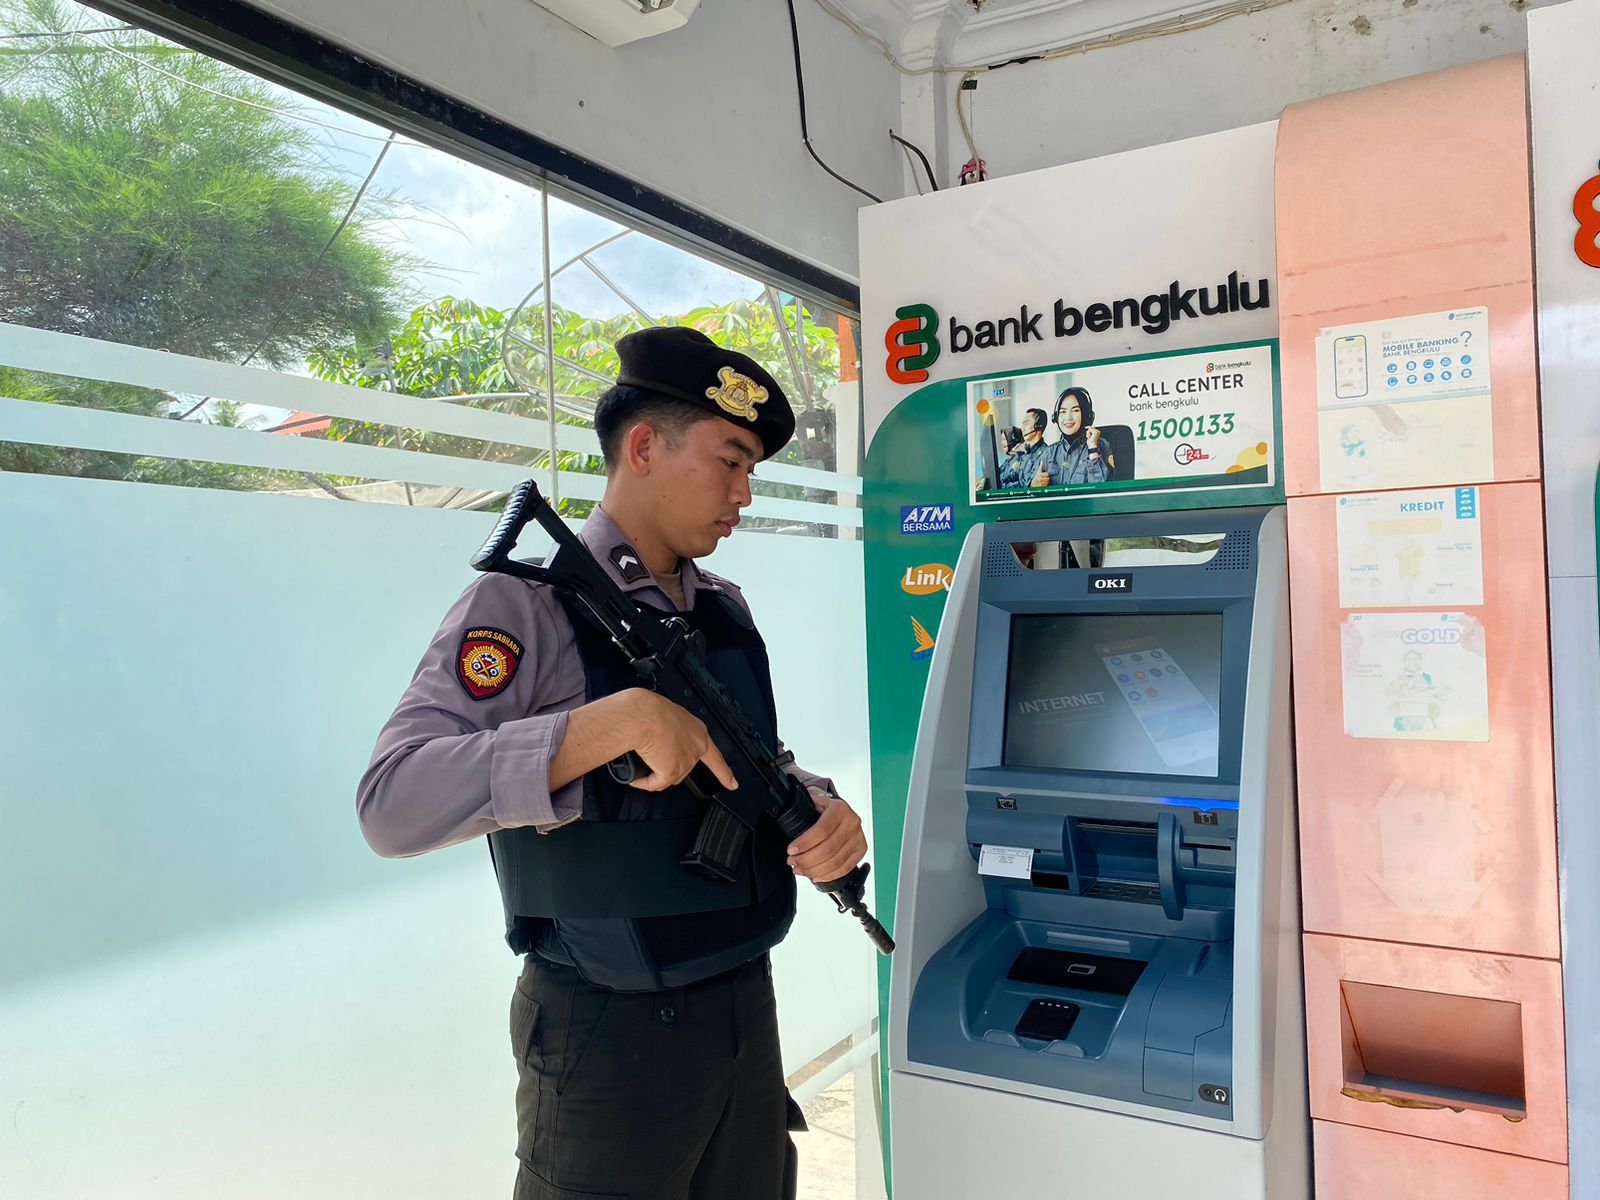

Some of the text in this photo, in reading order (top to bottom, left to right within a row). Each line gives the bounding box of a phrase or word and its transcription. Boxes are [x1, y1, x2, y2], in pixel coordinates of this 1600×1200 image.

[950, 270, 1270, 353] bank bengkulu
[1383, 343, 1415, 353] MOBILE
[1417, 337, 1459, 348] BANKING
[1383, 350, 1401, 358] BANK
[1403, 346, 1440, 356] BENGKULU
[1128, 373, 1244, 399] CALL CENTER
[1129, 396, 1199, 412] bank bengkulu
[1136, 412, 1236, 442] 1500133
[1187, 450, 1201, 460] 24
[903, 506, 951, 523] ATM
[1400, 501, 1445, 512] KREDIT
[903, 521, 951, 532] BERSAMA
[905, 566, 951, 592] Link
[1094, 578, 1127, 590] OKI
[468, 631, 520, 656] KORPS SABHARA
[1401, 629, 1461, 644] GOLD
[910, 648, 933, 661] GP
[1018, 691, 1105, 714] INTERNET
